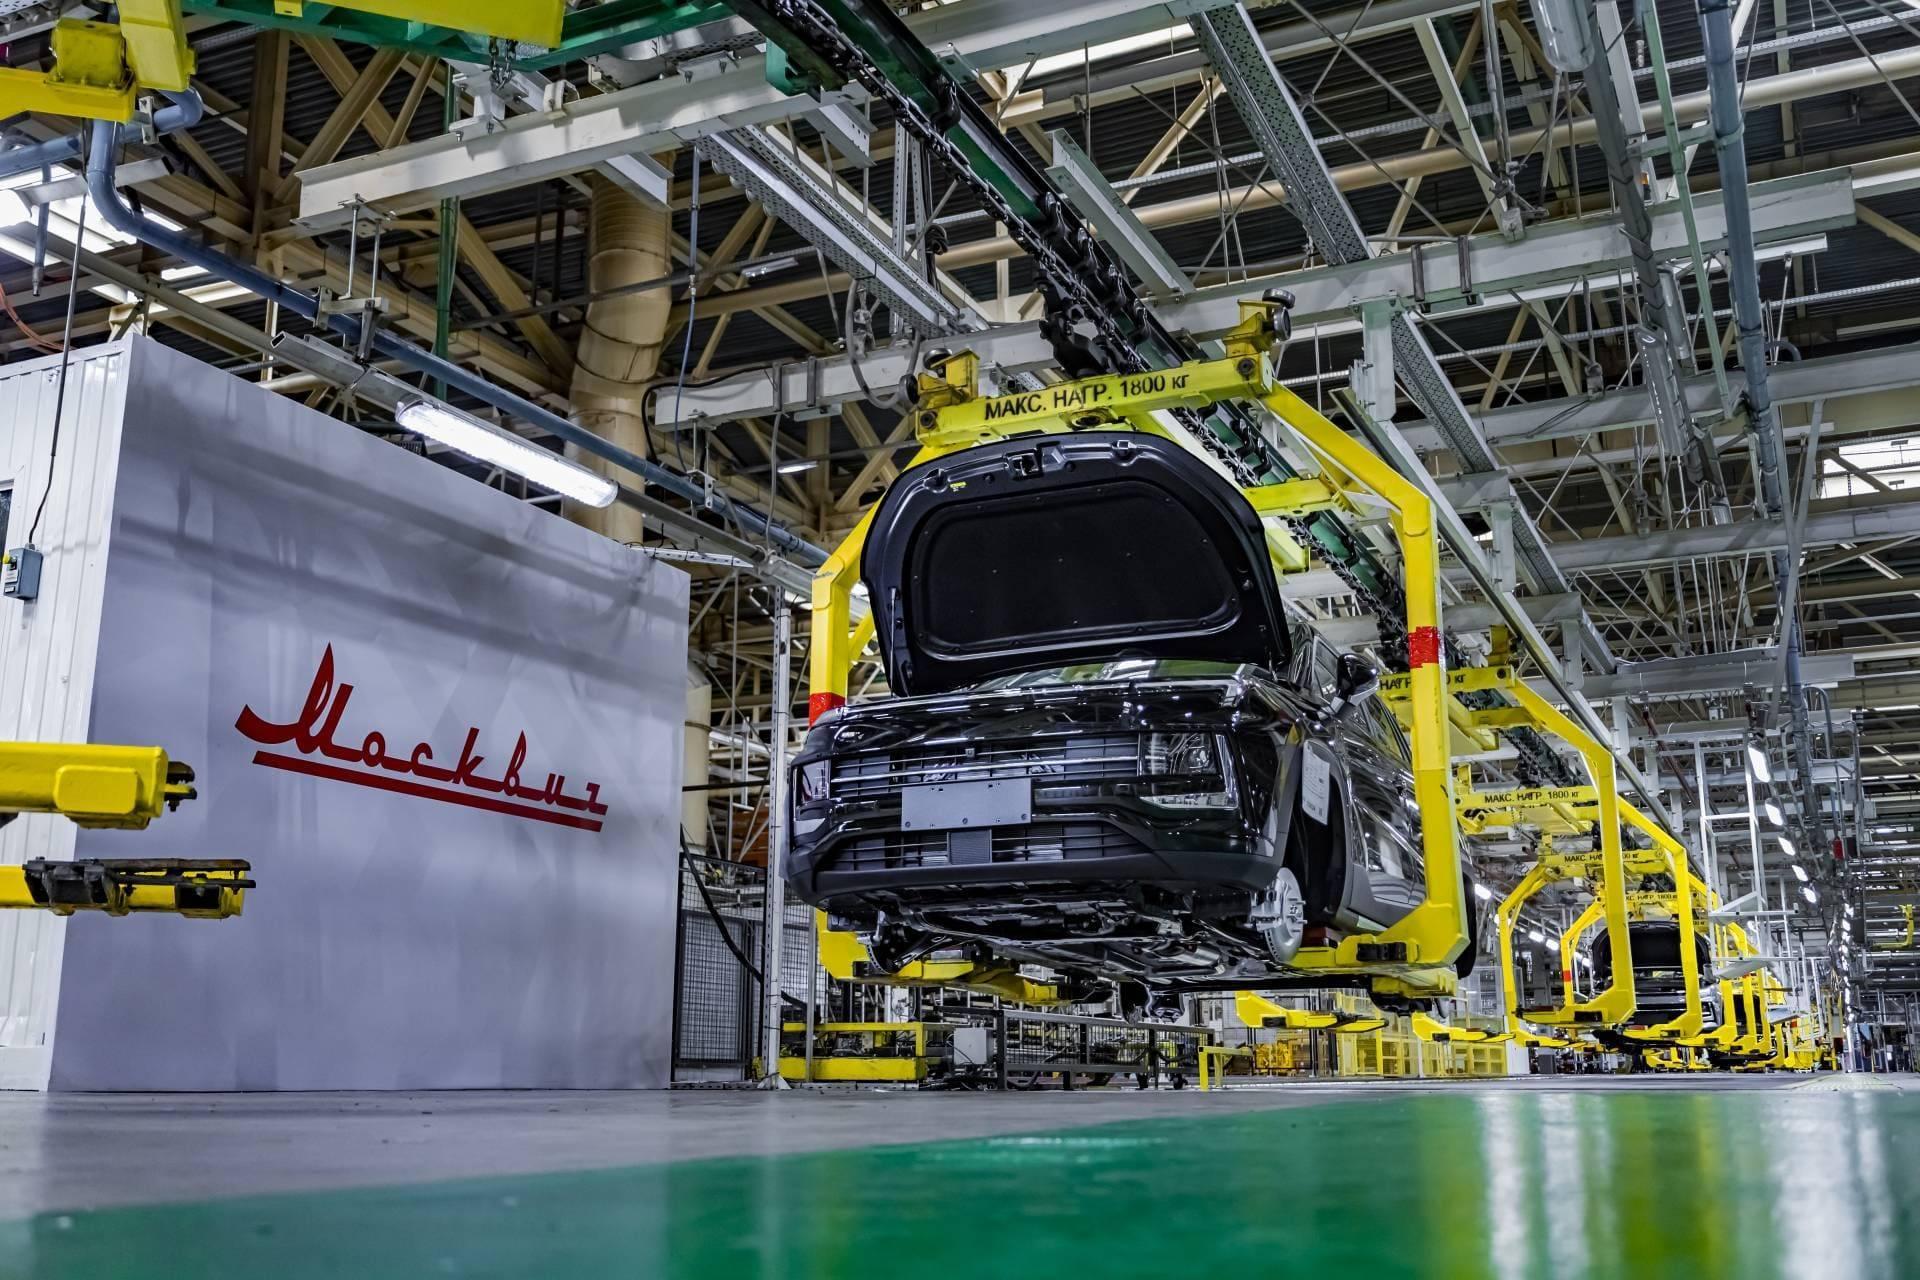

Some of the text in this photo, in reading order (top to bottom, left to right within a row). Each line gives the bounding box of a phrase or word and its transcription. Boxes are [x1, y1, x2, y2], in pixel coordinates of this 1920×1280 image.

[984, 374, 1190, 421] МАКС. НАГР. 1800 кг
[234, 640, 608, 816] Москвич
[1547, 789, 1570, 800] 1800
